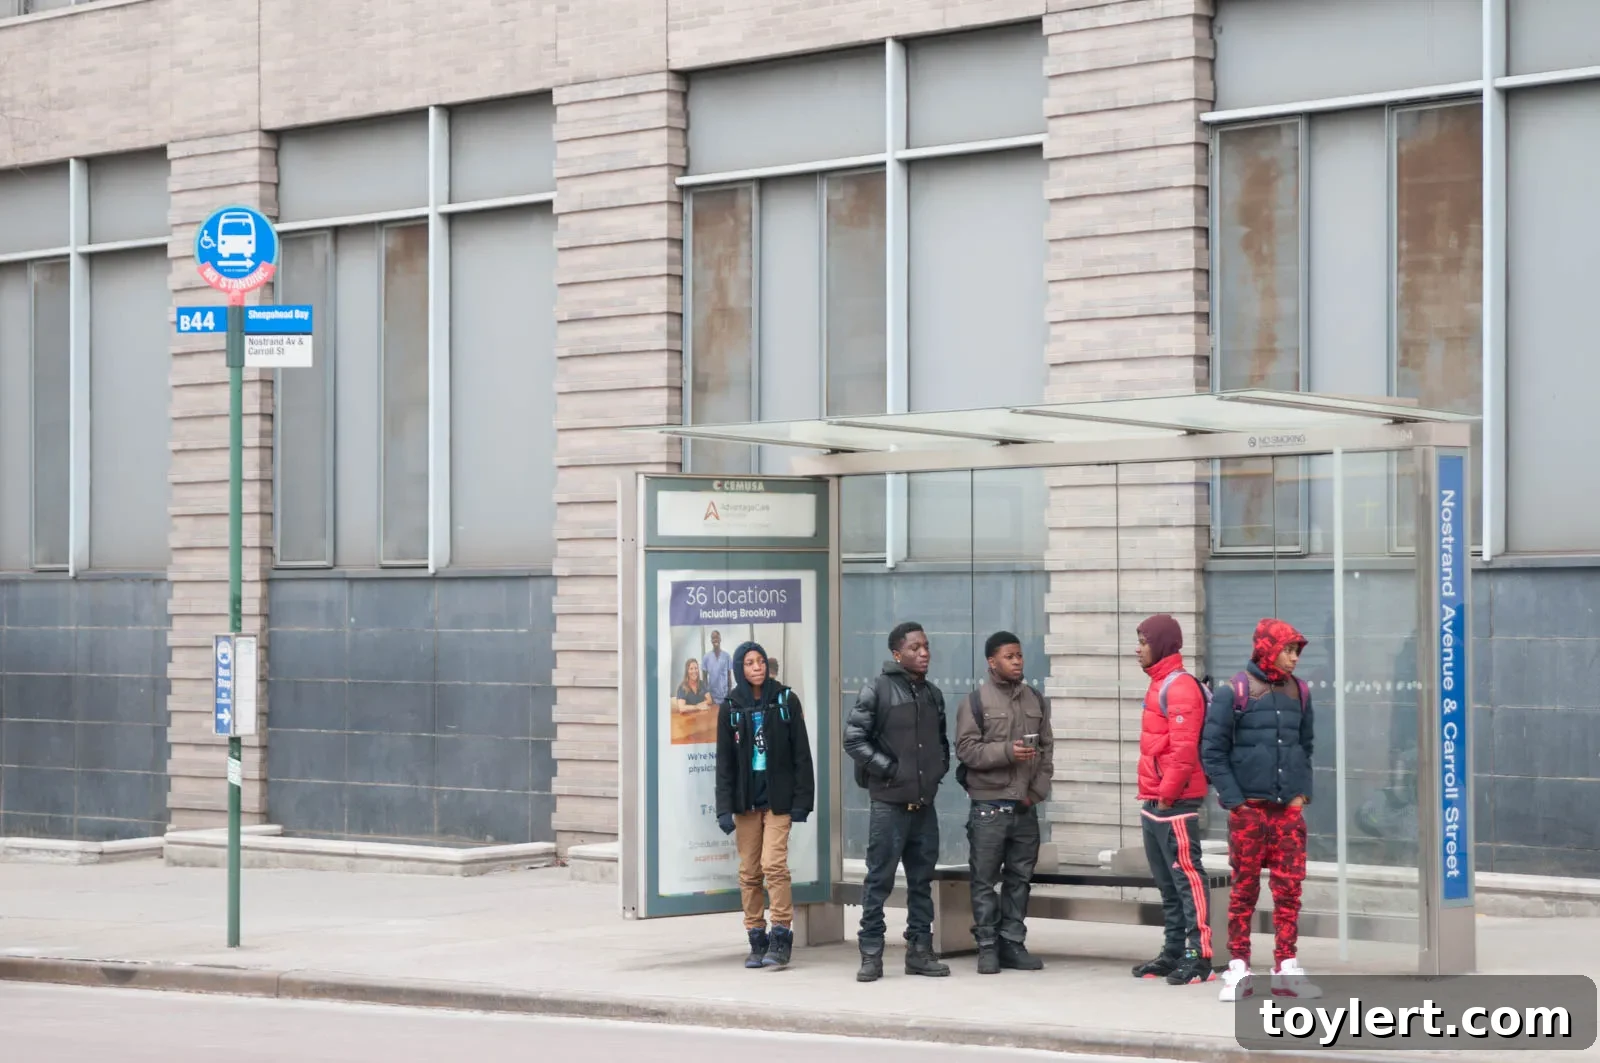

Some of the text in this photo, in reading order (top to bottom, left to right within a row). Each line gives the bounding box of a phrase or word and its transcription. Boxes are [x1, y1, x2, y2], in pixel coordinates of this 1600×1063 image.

[203, 266, 269, 289] NO STANDING
[295, 309, 309, 320] Bay
[180, 311, 216, 331] B44
[248, 337, 304, 346] Nostrand Av &
[248, 346, 285, 356] Carroll St
[724, 480, 765, 492] CEMUSA
[686, 585, 788, 605] 36 locations
[740, 608, 777, 618] Brooklyn
[1441, 490, 1460, 877] Nostrand Avenue & Carroll Street
